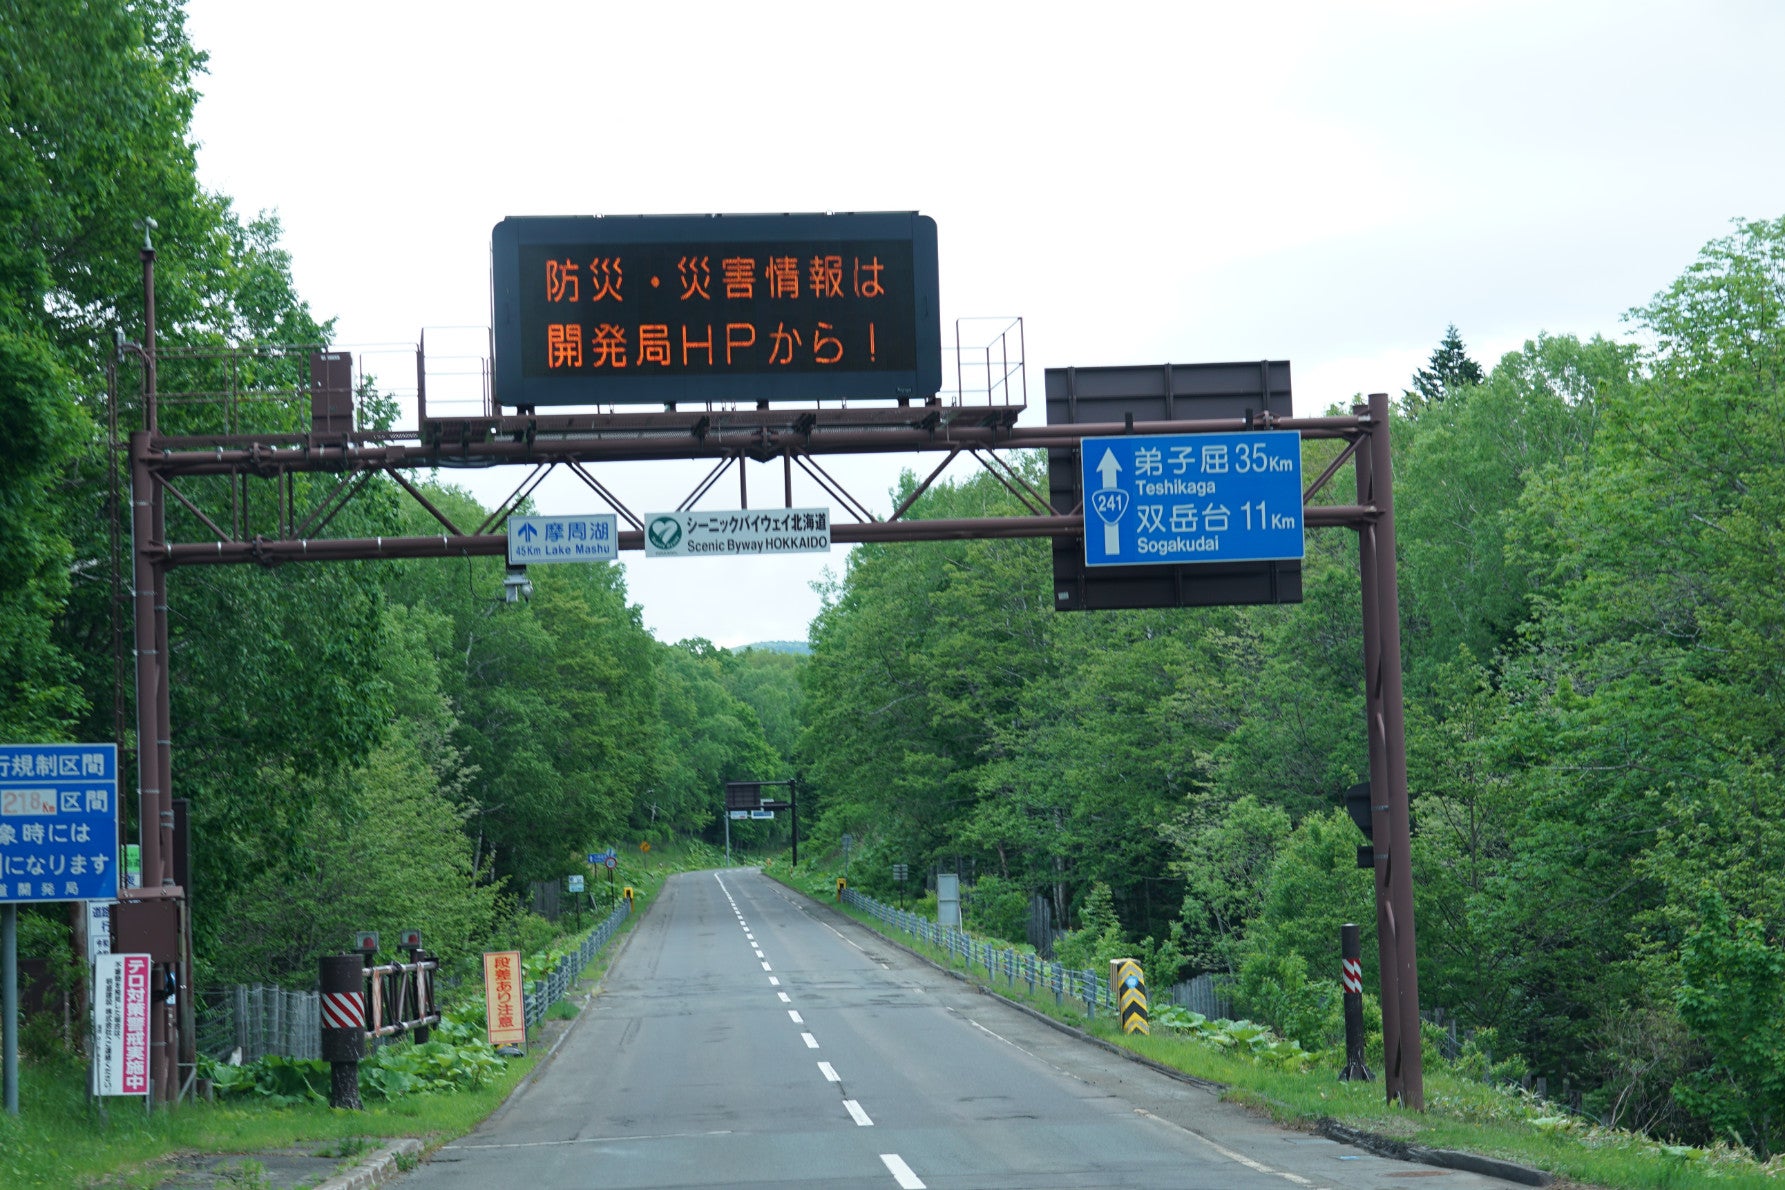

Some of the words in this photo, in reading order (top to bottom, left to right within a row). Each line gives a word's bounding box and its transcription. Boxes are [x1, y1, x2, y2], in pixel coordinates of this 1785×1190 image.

[546, 255, 885, 302] 防災・災害情報は
[1134, 444, 1229, 477] 弟子屈
[1135, 479, 1217, 496] Teshikaga
[1098, 494, 1122, 512] 241
[687, 513, 827, 535] シーニックバイウェイ北海道
[1137, 502, 1231, 534] 双岳台
[545, 521, 609, 542] 摩周湖
[545, 544, 571, 556] Lake
[575, 543, 610, 555] Mashu
[687, 539, 725, 552] Scenic
[727, 538, 764, 553] Byway
[766, 536, 828, 550] HOKKAIDO
[1137, 535, 1219, 556] Sogakudai
[60, 789, 108, 813] 区間
[0, 853, 109, 879] になります
[494, 956, 514, 1028] 段差あり注意
